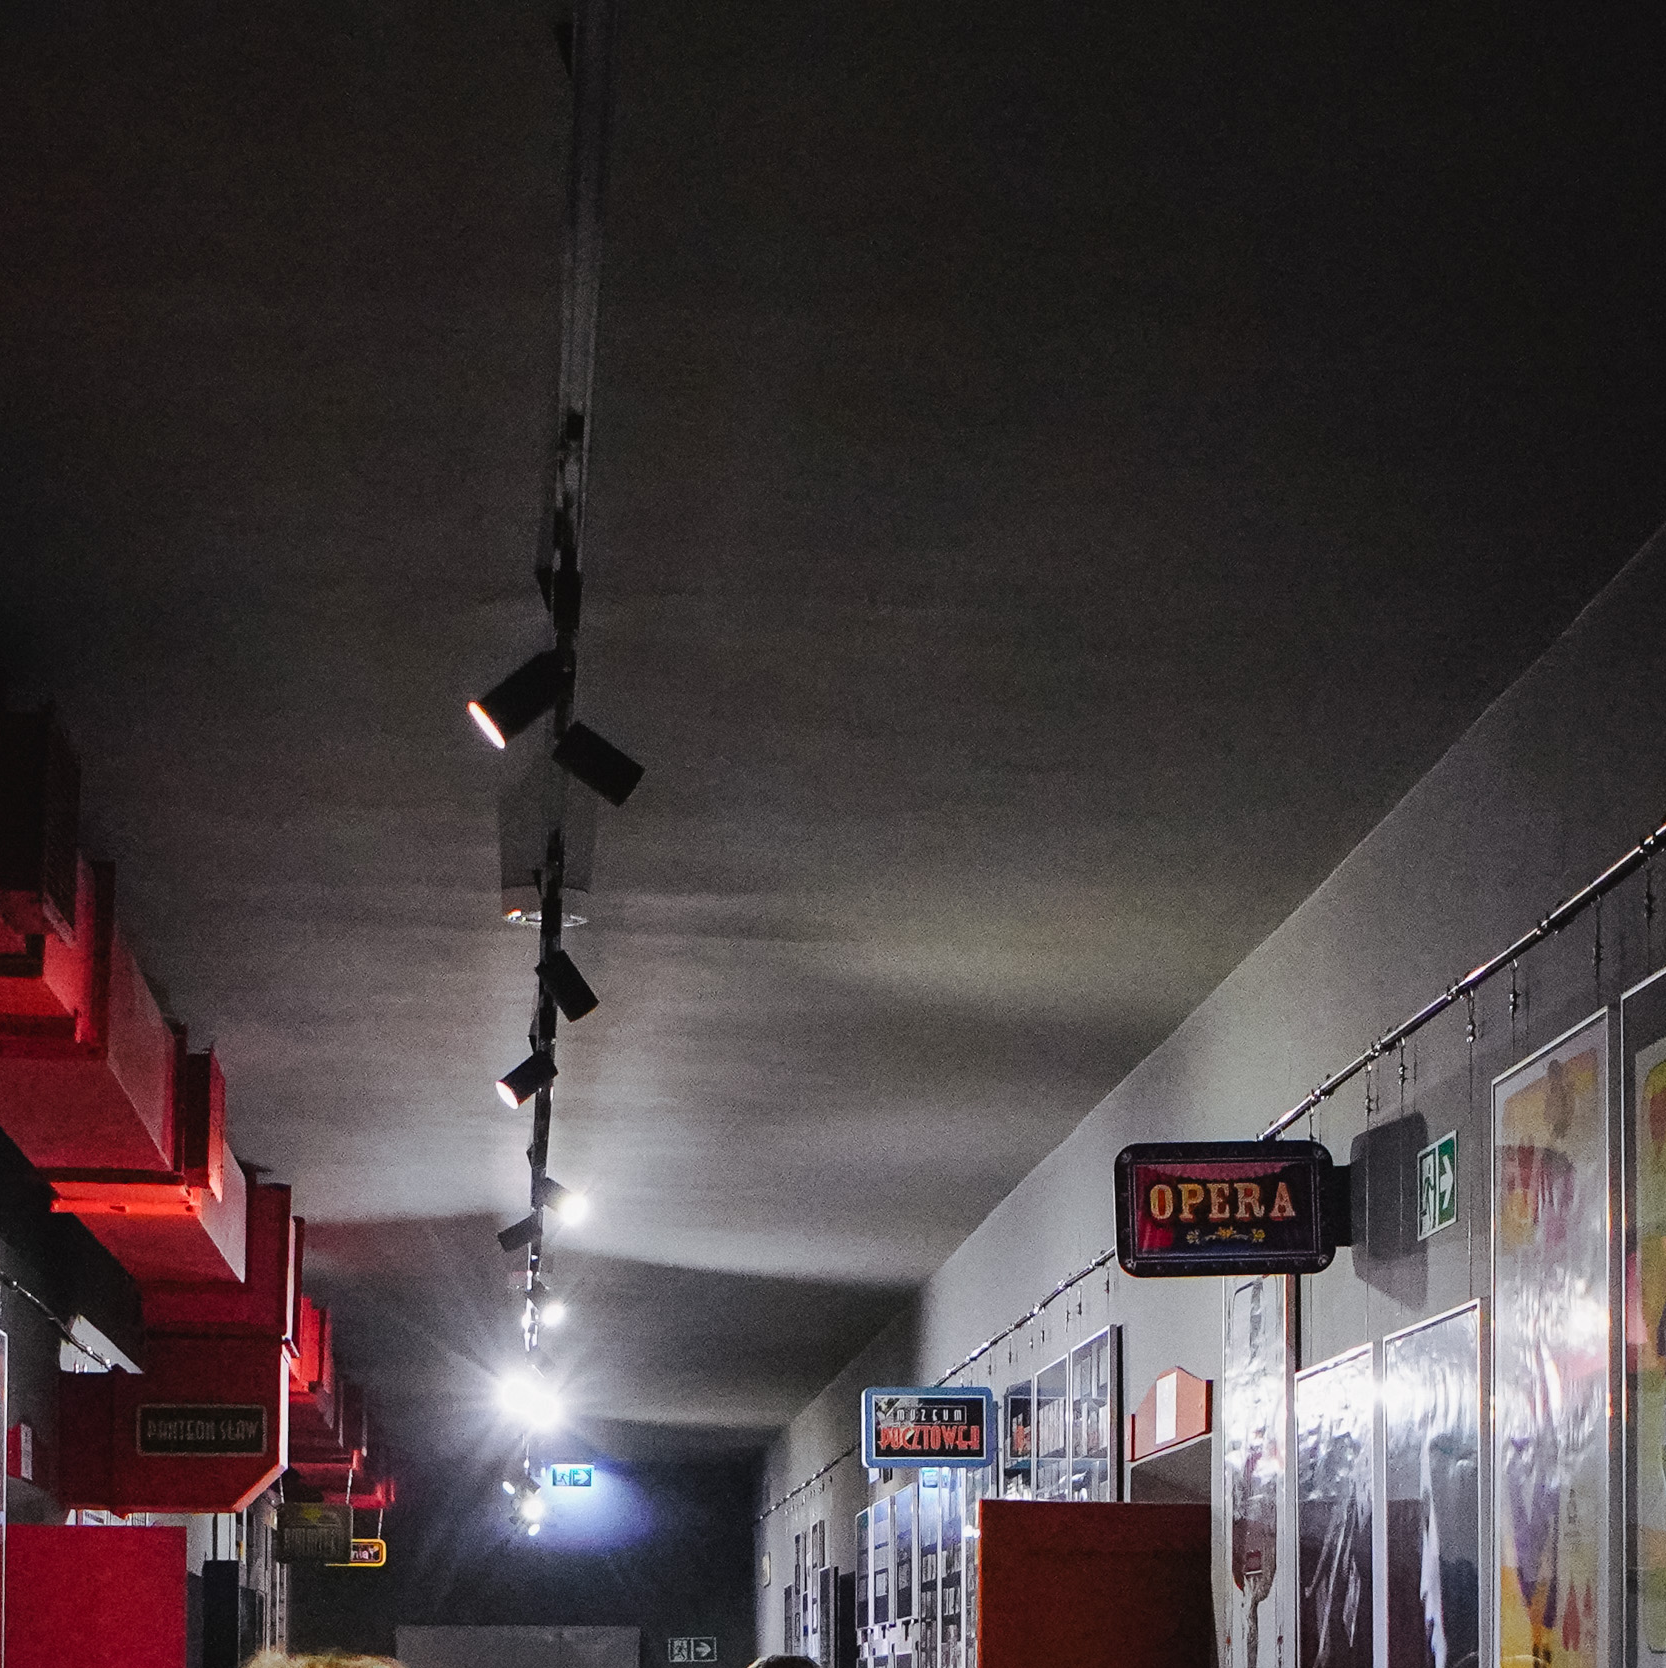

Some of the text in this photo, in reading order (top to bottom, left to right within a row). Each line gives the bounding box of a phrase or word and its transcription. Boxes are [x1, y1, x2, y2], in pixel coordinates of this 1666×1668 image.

[1149, 1181, 1296, 1222] OPERA
[896, 1408, 962, 1422] MUZEUM
[146, 1419, 216, 1441] PANTEON
